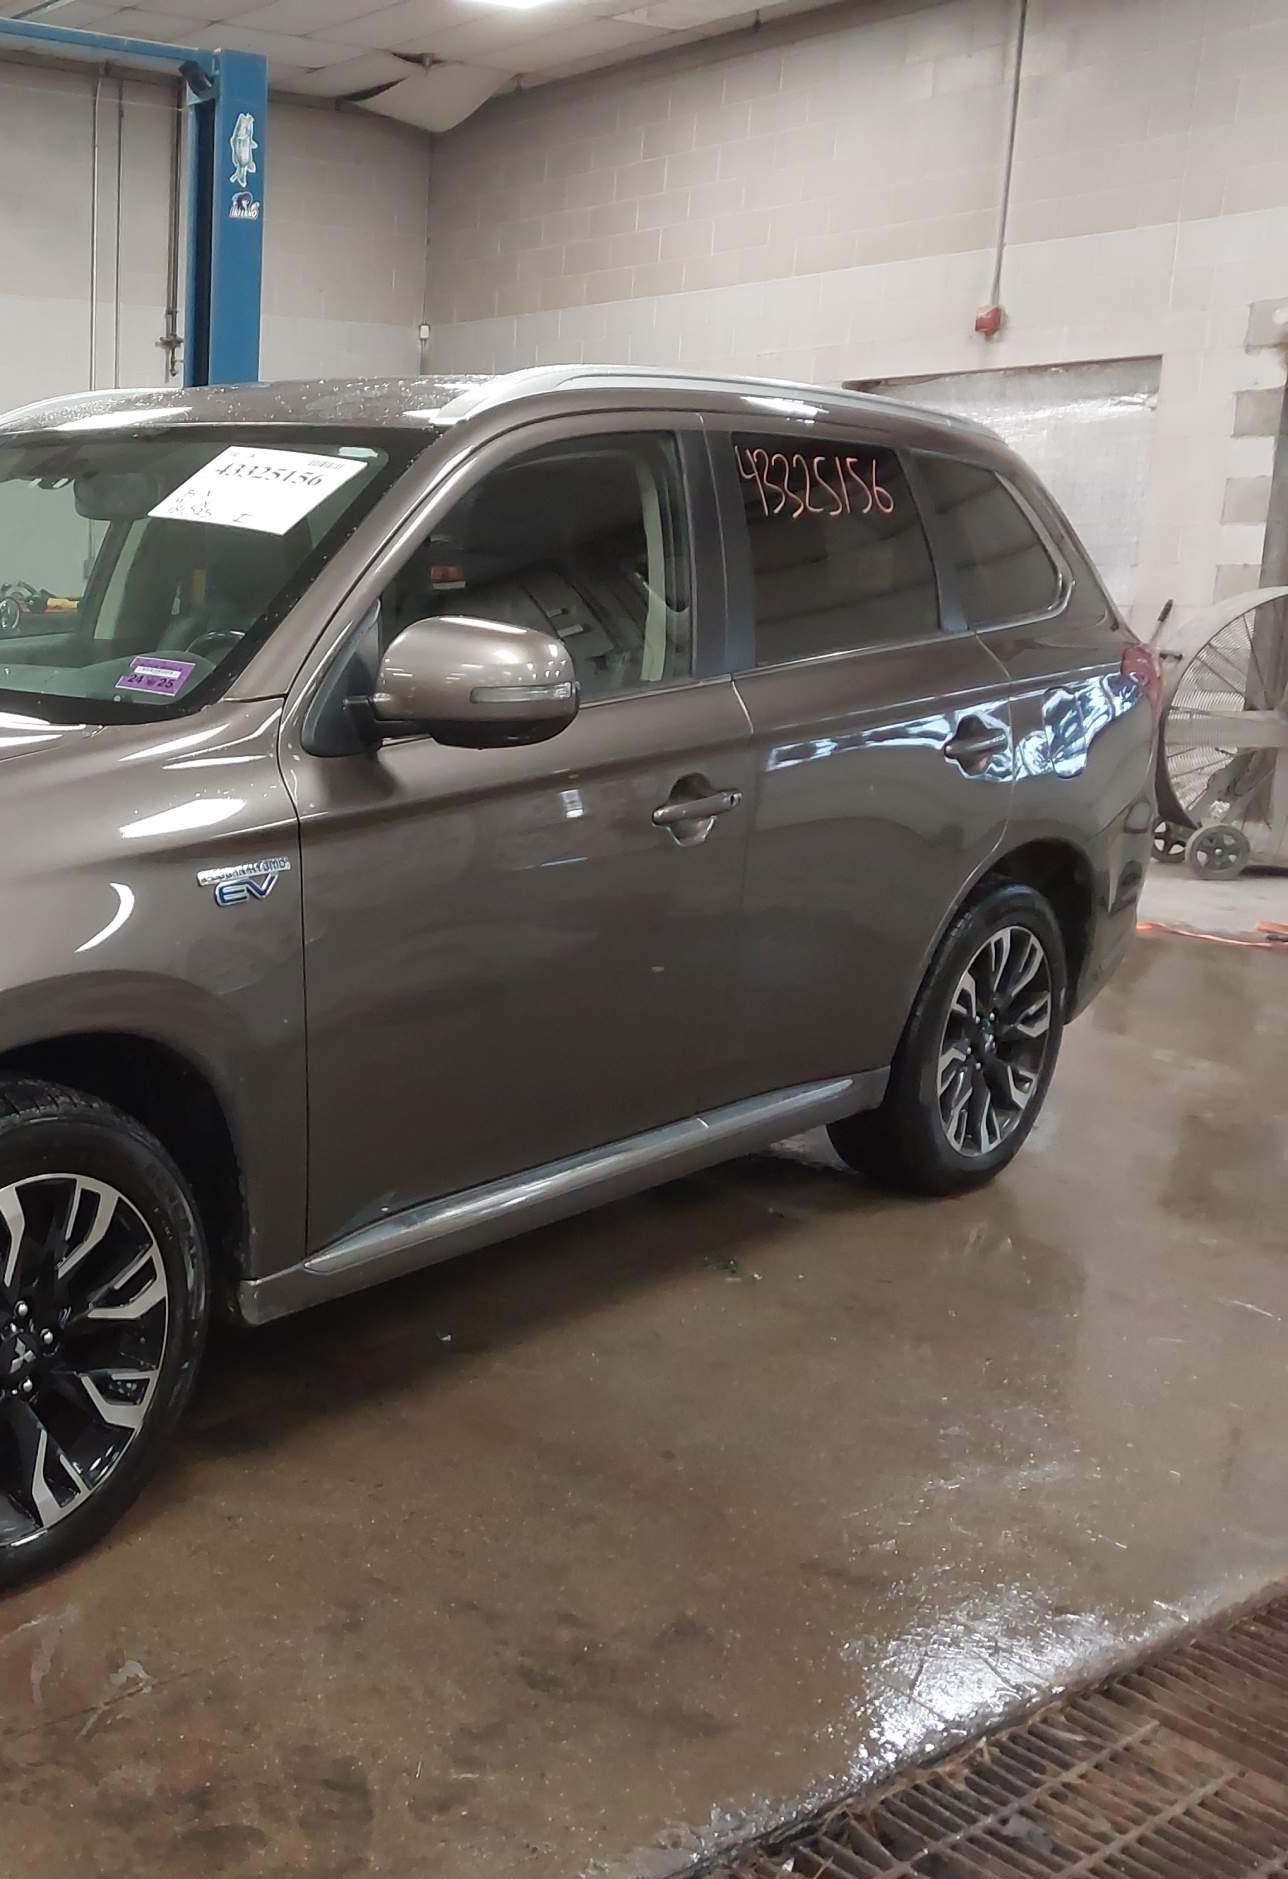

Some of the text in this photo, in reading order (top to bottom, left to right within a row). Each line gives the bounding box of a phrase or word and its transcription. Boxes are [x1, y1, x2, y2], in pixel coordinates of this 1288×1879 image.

[215, 462, 324, 487] 43325156
[734, 445, 894, 519] 43325156
[215, 872, 280, 906] EV
